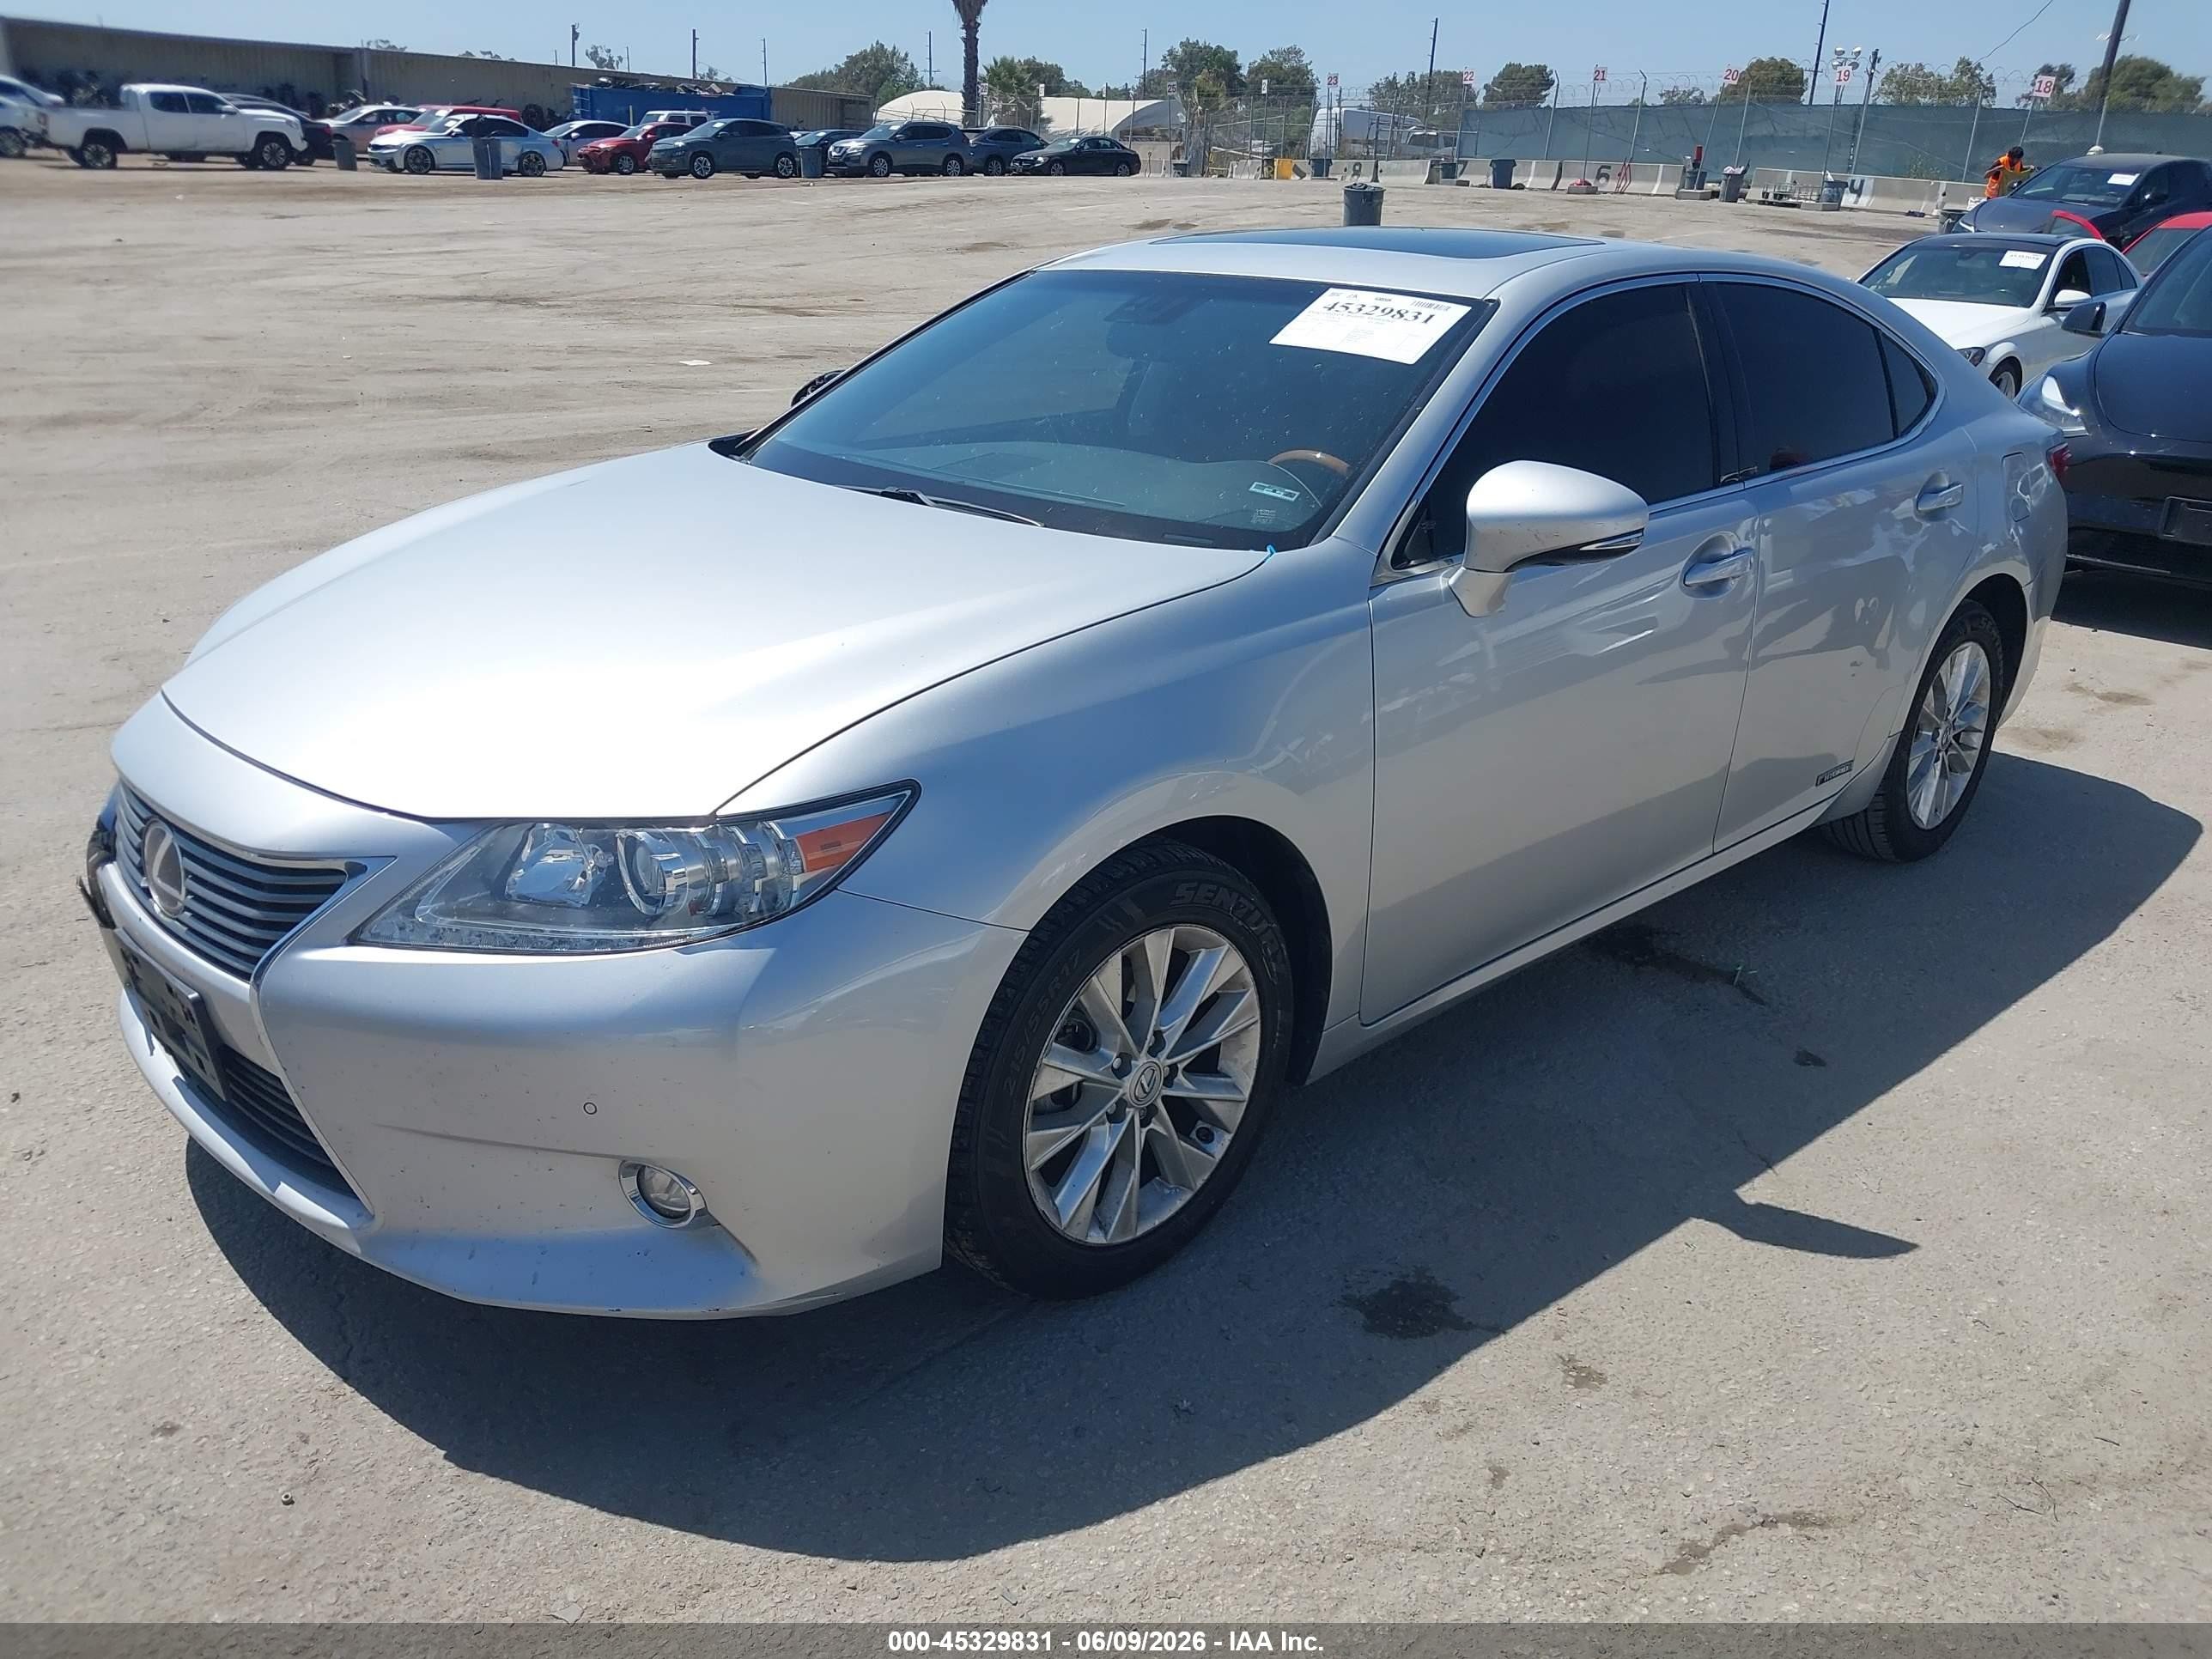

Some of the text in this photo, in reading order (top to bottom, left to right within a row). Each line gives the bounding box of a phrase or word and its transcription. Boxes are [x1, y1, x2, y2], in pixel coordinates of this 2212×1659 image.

[1328, 76, 1339, 86] 23
[1463, 70, 1474, 82] 22
[1594, 70, 1607, 82] 21
[1723, 69, 1740, 82] 20
[1836, 70, 1850, 82] 19
[1167, 84, 1176, 93] 25
[2035, 80, 2053, 94] 18
[1594, 165, 1612, 187] 6
[1849, 179, 1865, 204] 4
[1322, 301, 1436, 325] 45329831
